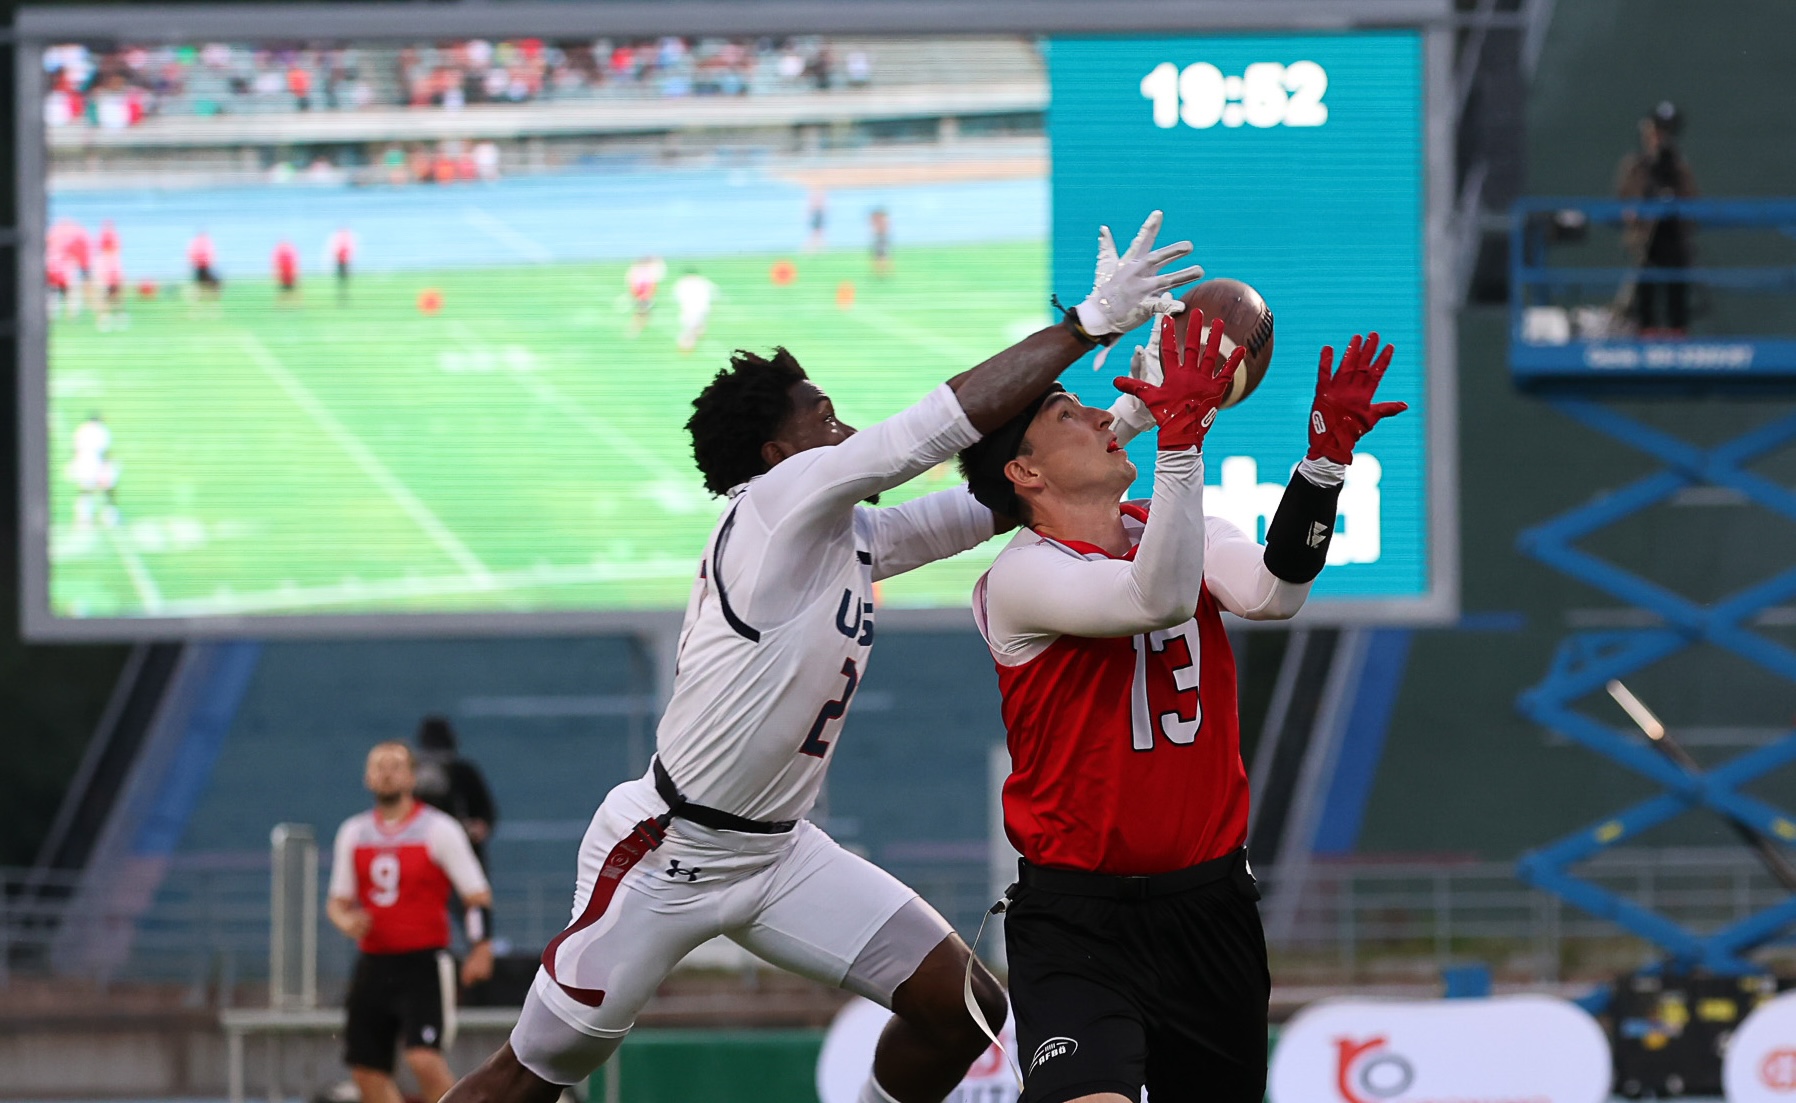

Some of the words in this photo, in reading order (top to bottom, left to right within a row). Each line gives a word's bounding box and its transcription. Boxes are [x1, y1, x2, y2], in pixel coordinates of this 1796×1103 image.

[1131, 616, 1202, 750] 13
[369, 853, 401, 908] 9
[1038, 1045, 1067, 1066] AFBÖ
